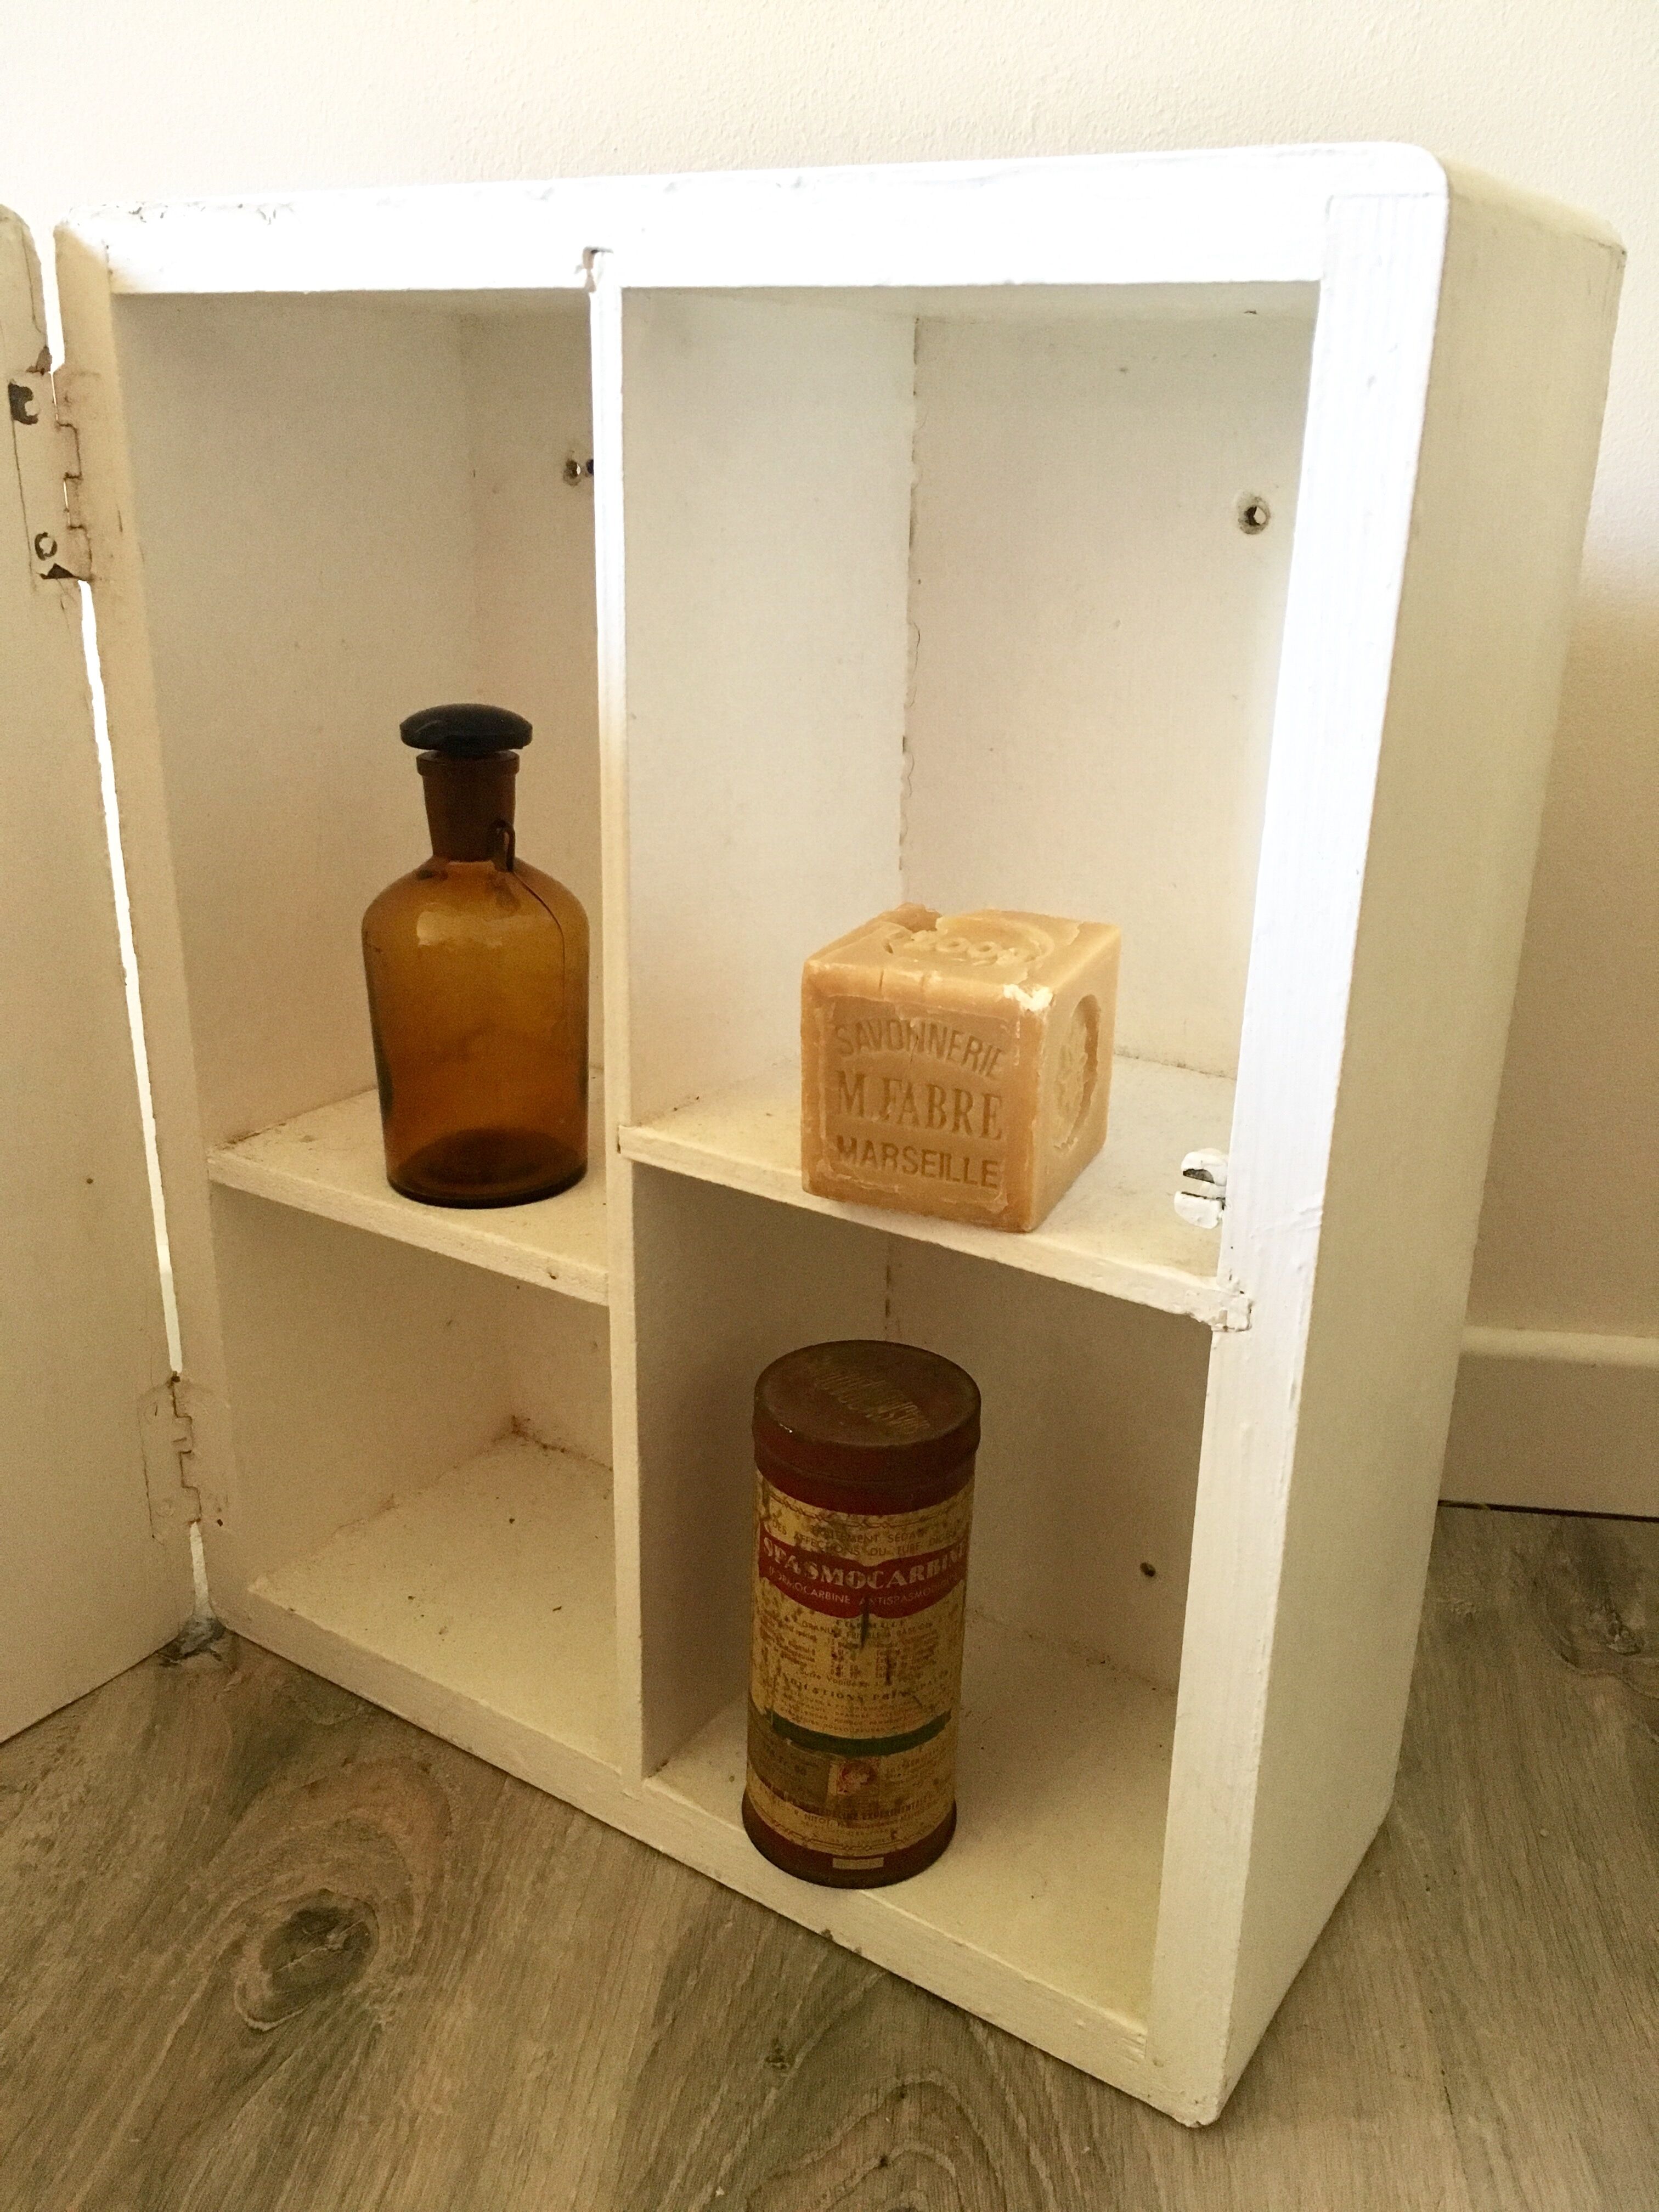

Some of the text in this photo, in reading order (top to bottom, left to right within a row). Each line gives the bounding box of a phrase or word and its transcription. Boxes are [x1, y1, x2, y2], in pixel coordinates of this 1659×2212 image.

[834, 1018, 1003, 1078] SAVONNERIE
[879, 1076, 1002, 1141] FABRE
[836, 1135, 998, 1189] MARSEILLE
[763, 1537, 967, 1589] SPASMOCARBINE
